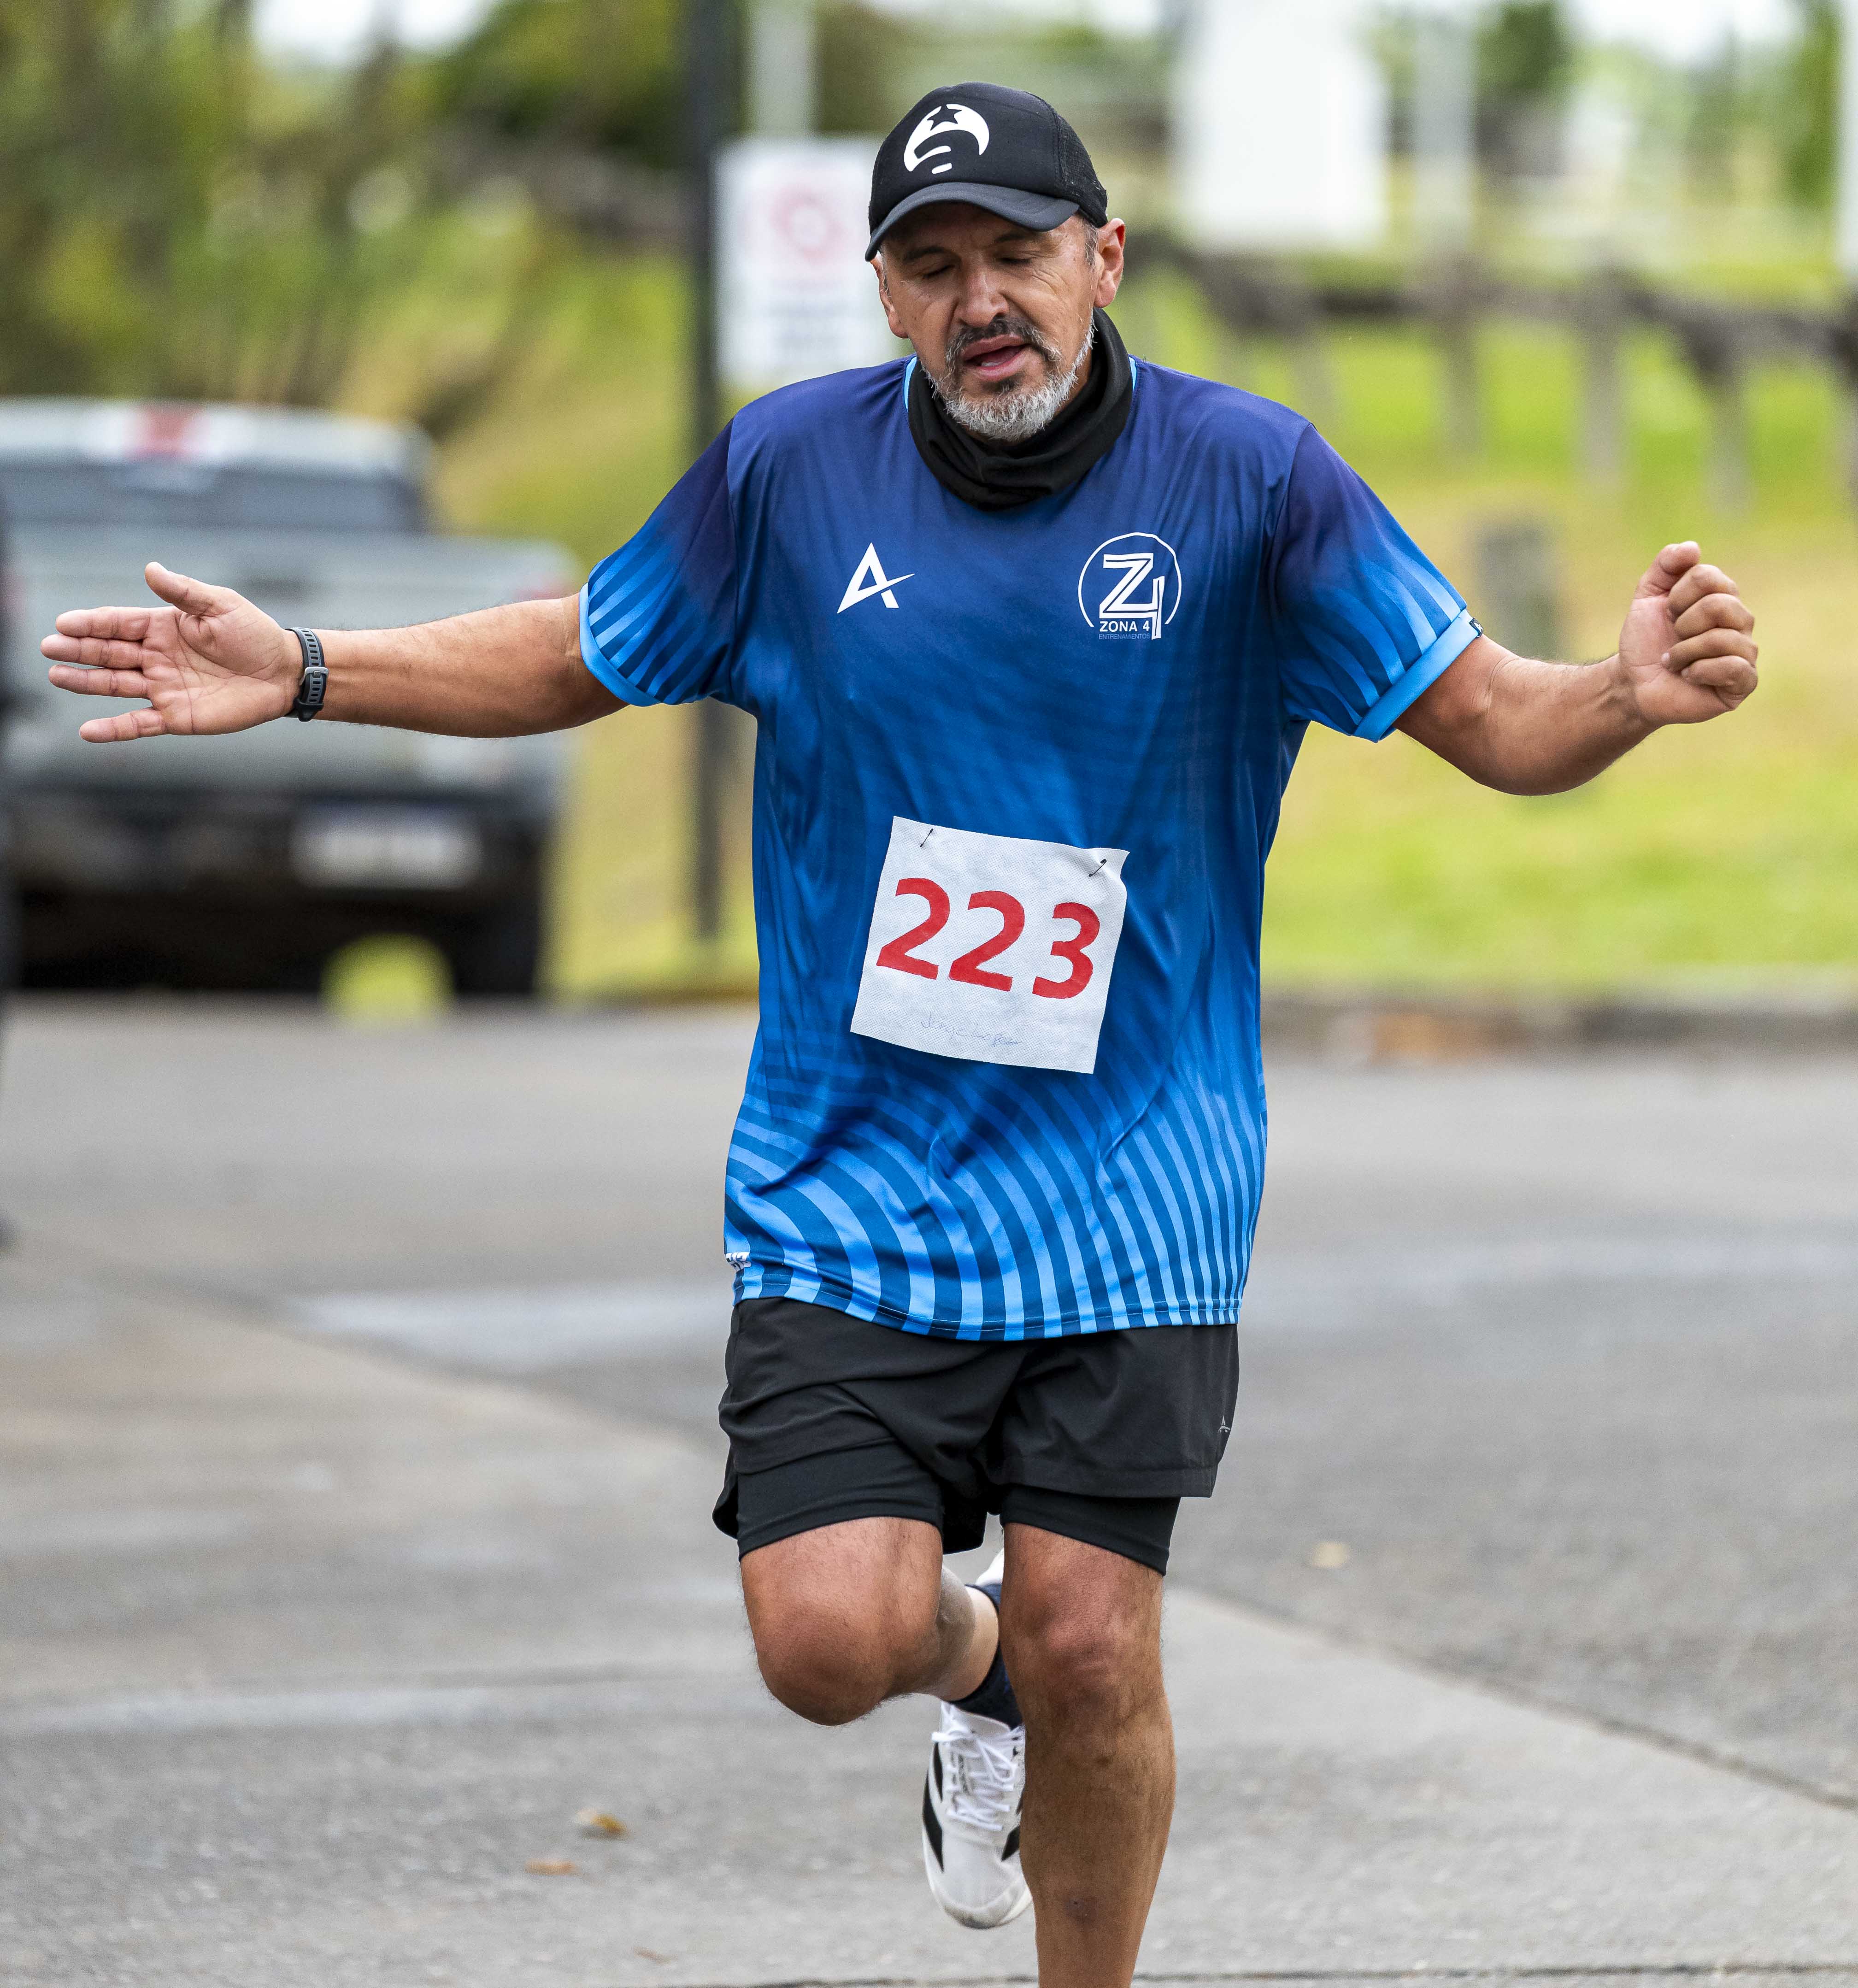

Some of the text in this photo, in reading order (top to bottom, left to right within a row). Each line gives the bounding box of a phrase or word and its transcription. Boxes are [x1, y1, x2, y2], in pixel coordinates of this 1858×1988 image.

[1100, 620, 1150, 632] ZONA 4
[876, 877, 1100, 999] 223
